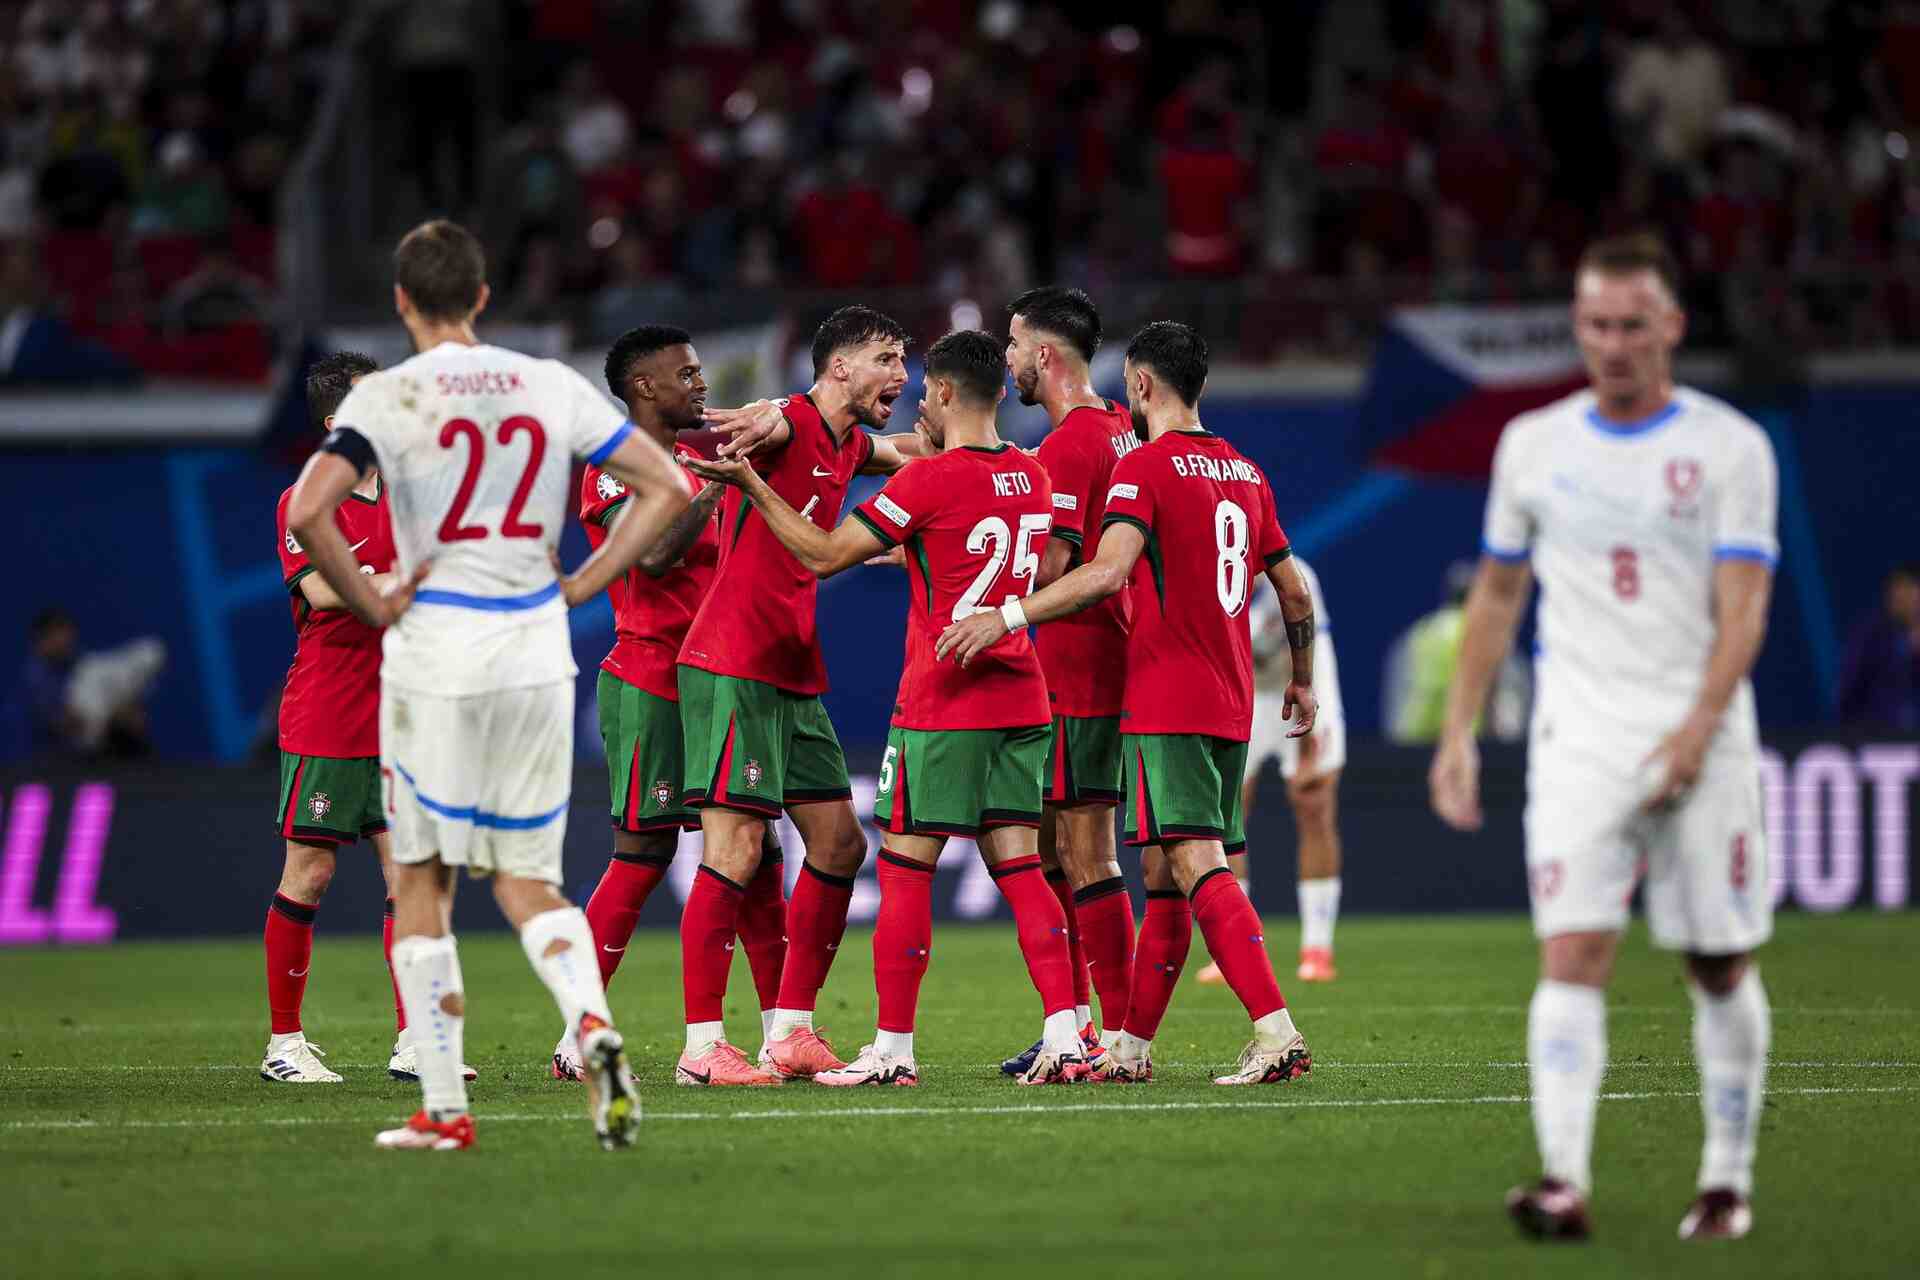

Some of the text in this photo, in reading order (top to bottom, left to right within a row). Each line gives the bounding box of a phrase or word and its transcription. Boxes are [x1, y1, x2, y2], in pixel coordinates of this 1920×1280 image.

[438, 415, 546, 542] 22
[991, 471, 1032, 497] NETO
[1171, 454, 1261, 484] B.FENANDES
[951, 513, 1053, 623] 25
[1215, 499, 1249, 618] 8
